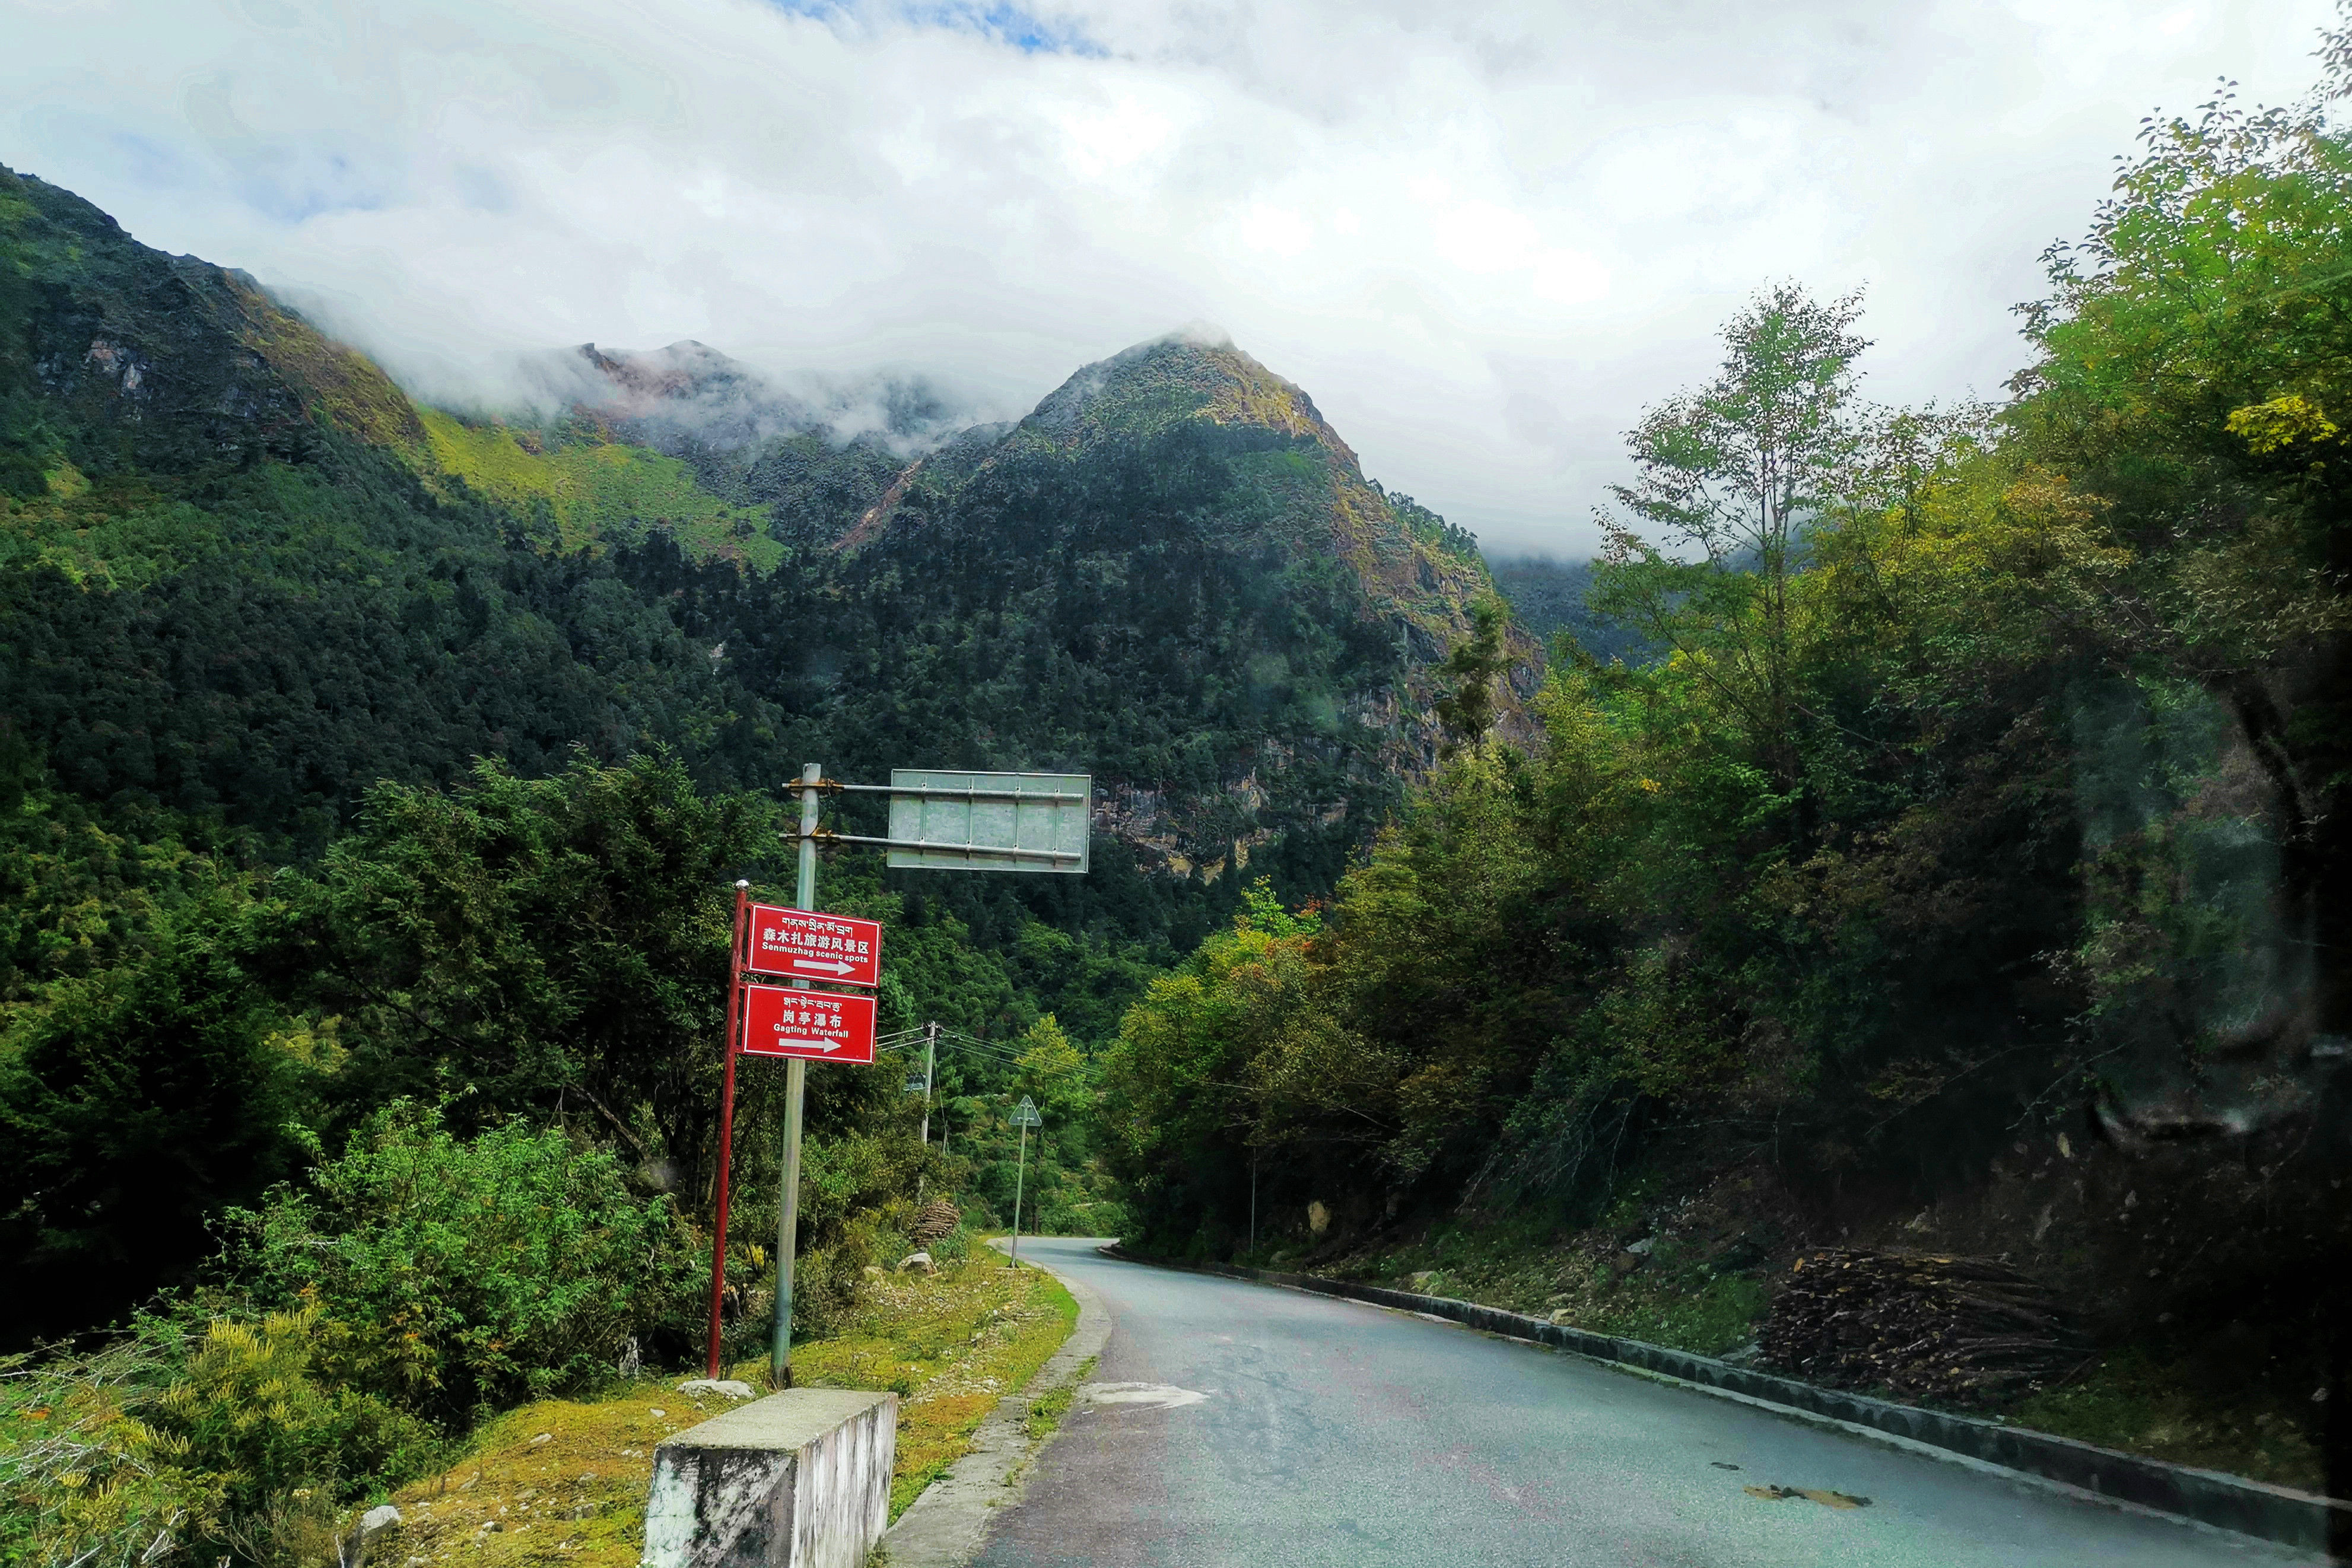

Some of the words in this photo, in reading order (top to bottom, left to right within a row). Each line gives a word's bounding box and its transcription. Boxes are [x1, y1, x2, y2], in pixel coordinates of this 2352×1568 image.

[763, 927, 869, 954] 森木扎旅游风景区
[762, 942, 814, 958] Senmuzhag
[816, 950, 843, 960] scenic
[844, 955, 868, 963] spots
[783, 1010, 842, 1028] 岗亭瀑布
[774, 1023, 808, 1035] Gagting
[812, 1028, 848, 1038] Waterfall
